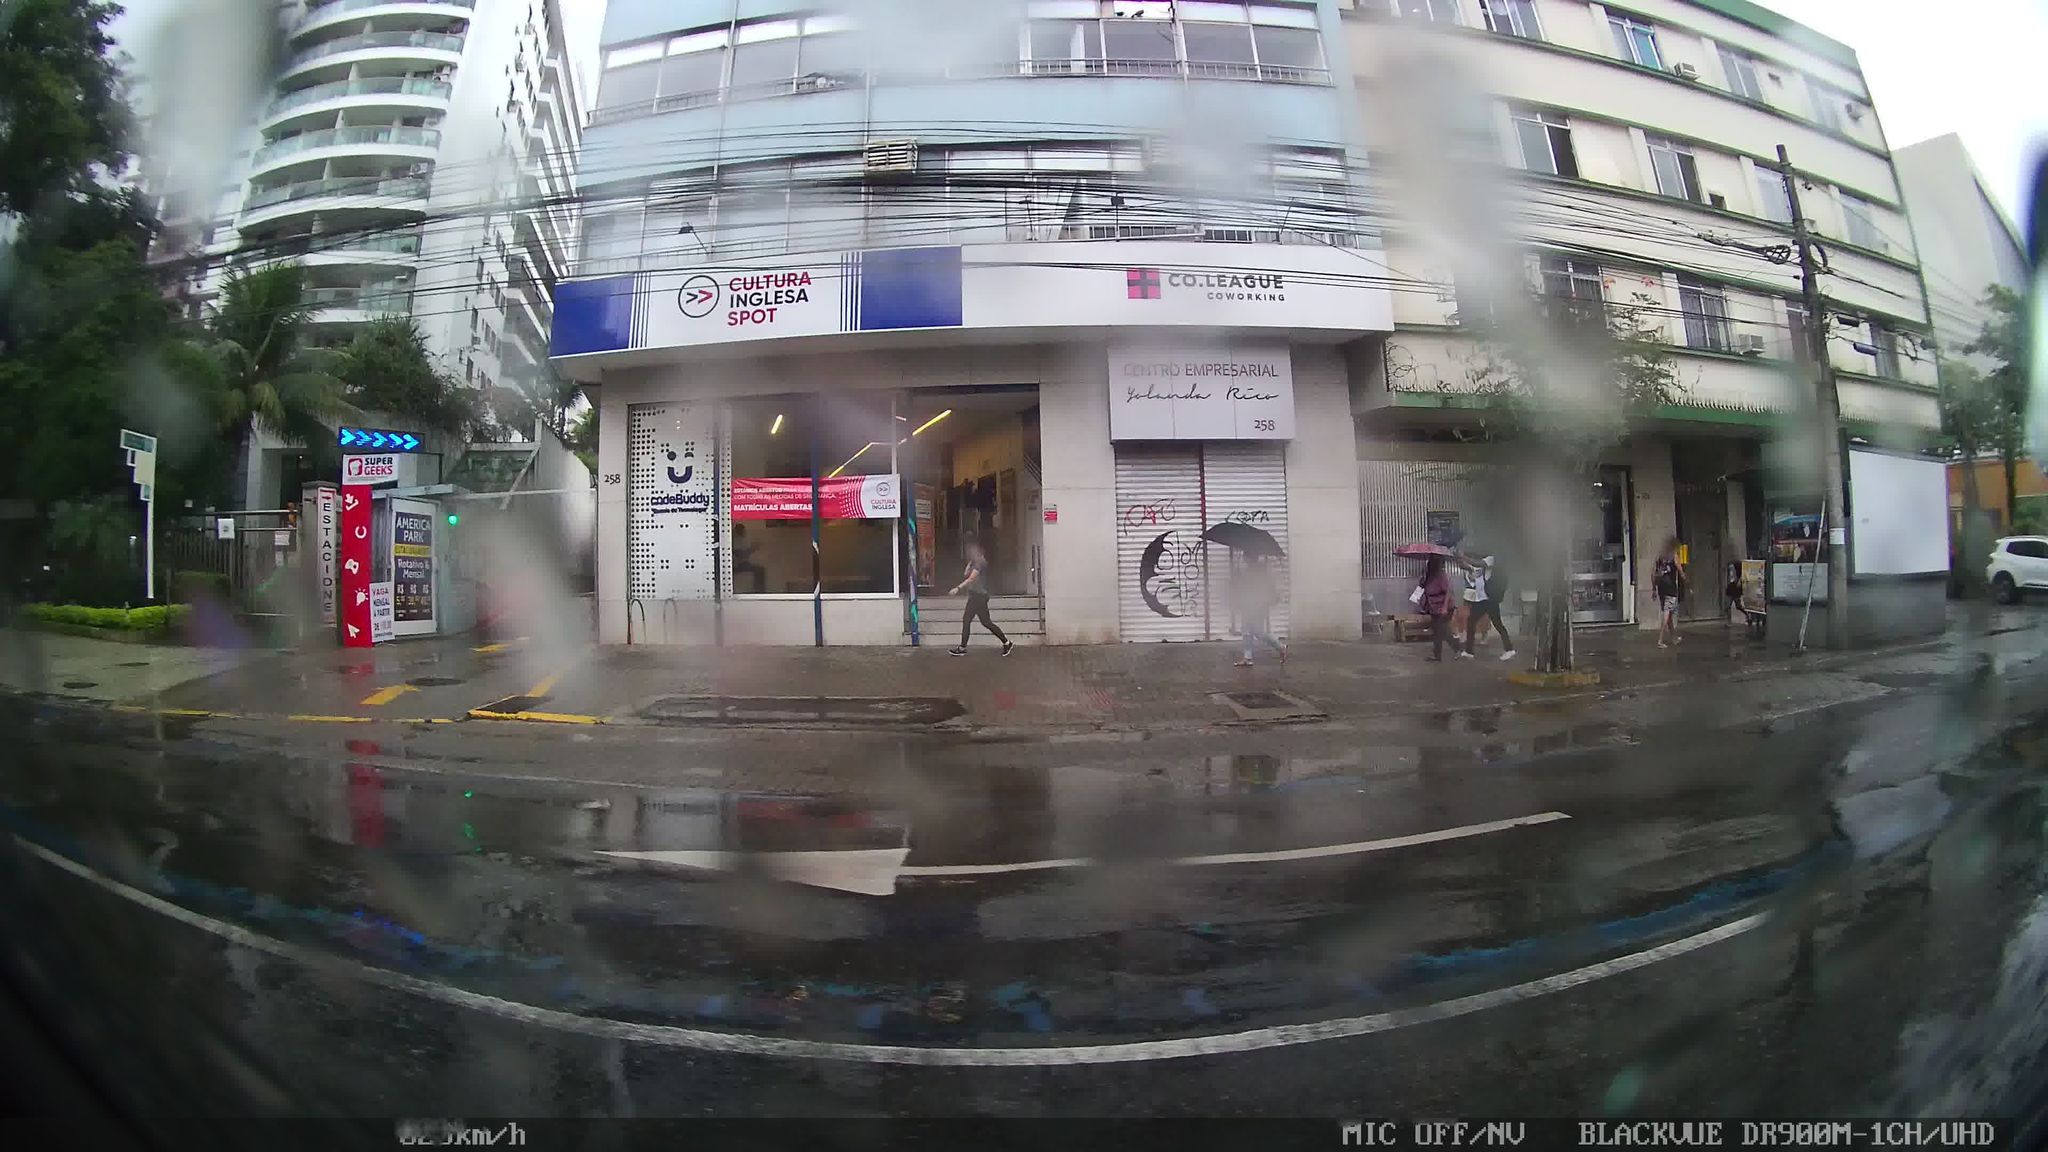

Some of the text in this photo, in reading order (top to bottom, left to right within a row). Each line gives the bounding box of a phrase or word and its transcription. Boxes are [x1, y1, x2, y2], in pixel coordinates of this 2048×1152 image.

[729, 272, 811, 291] CULTURA
[1169, 273, 1285, 289] CO.LEAGUE
[730, 288, 808, 308] INGLESA
[1207, 292, 1285, 301] COWORKING
[728, 308, 777, 326] SPOT
[1123, 362, 1279, 377] CENTRO EMPRESARIAL
[1126, 383, 1280, 403] Yolanda Rico
[1254, 419, 1275, 431] 258
[364, 457, 393, 465] SUPER
[364, 466, 393, 476] GEEKS
[604, 474, 621, 485] 258
[651, 493, 709, 506] codeBuddy
[734, 502, 812, 511] MATRÍCULAS ABERTAS
[397, 516, 431, 530] AMERICA
[403, 530, 424, 542] PARK
[372, 587, 389, 596] VAGA
